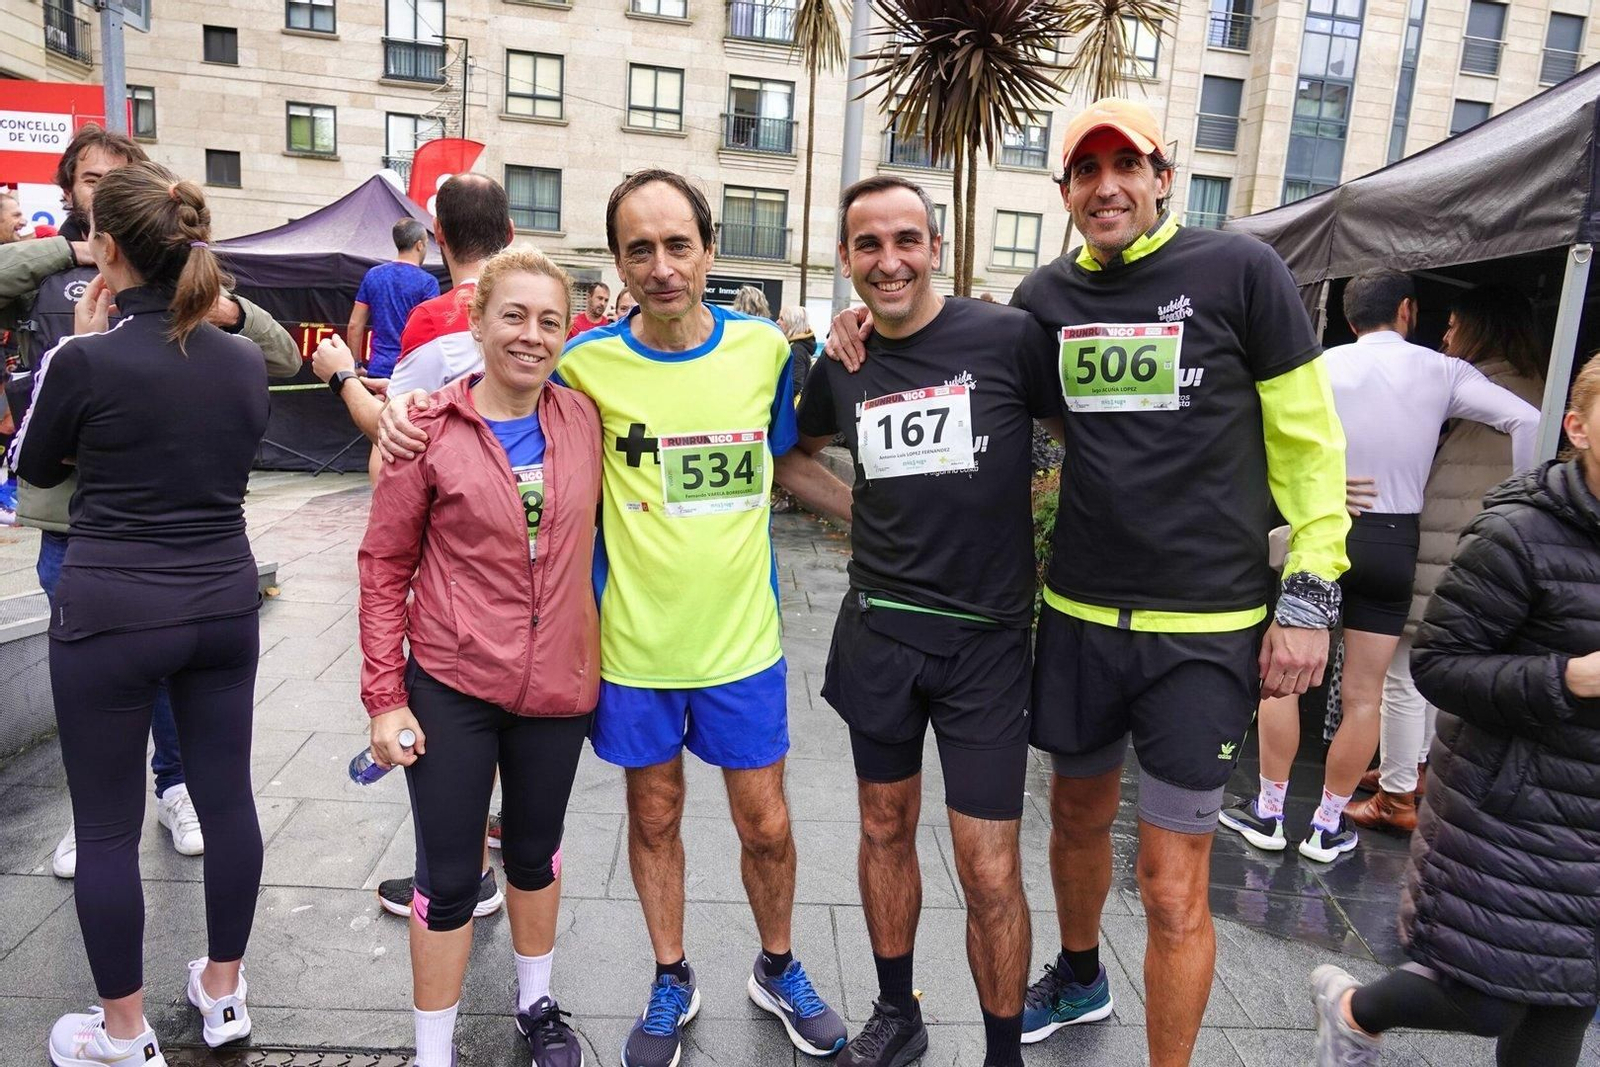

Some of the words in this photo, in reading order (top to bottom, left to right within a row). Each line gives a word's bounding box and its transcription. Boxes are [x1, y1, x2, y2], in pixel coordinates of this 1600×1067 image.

[0, 119, 67, 132] CONCELLO
[9, 132, 25, 142] DE
[30, 133, 59, 144] VIGO
[1076, 344, 1158, 384] 506
[877, 407, 950, 450] 167
[921, 447, 950, 455] FERNANDEZ
[682, 450, 755, 490] 534
